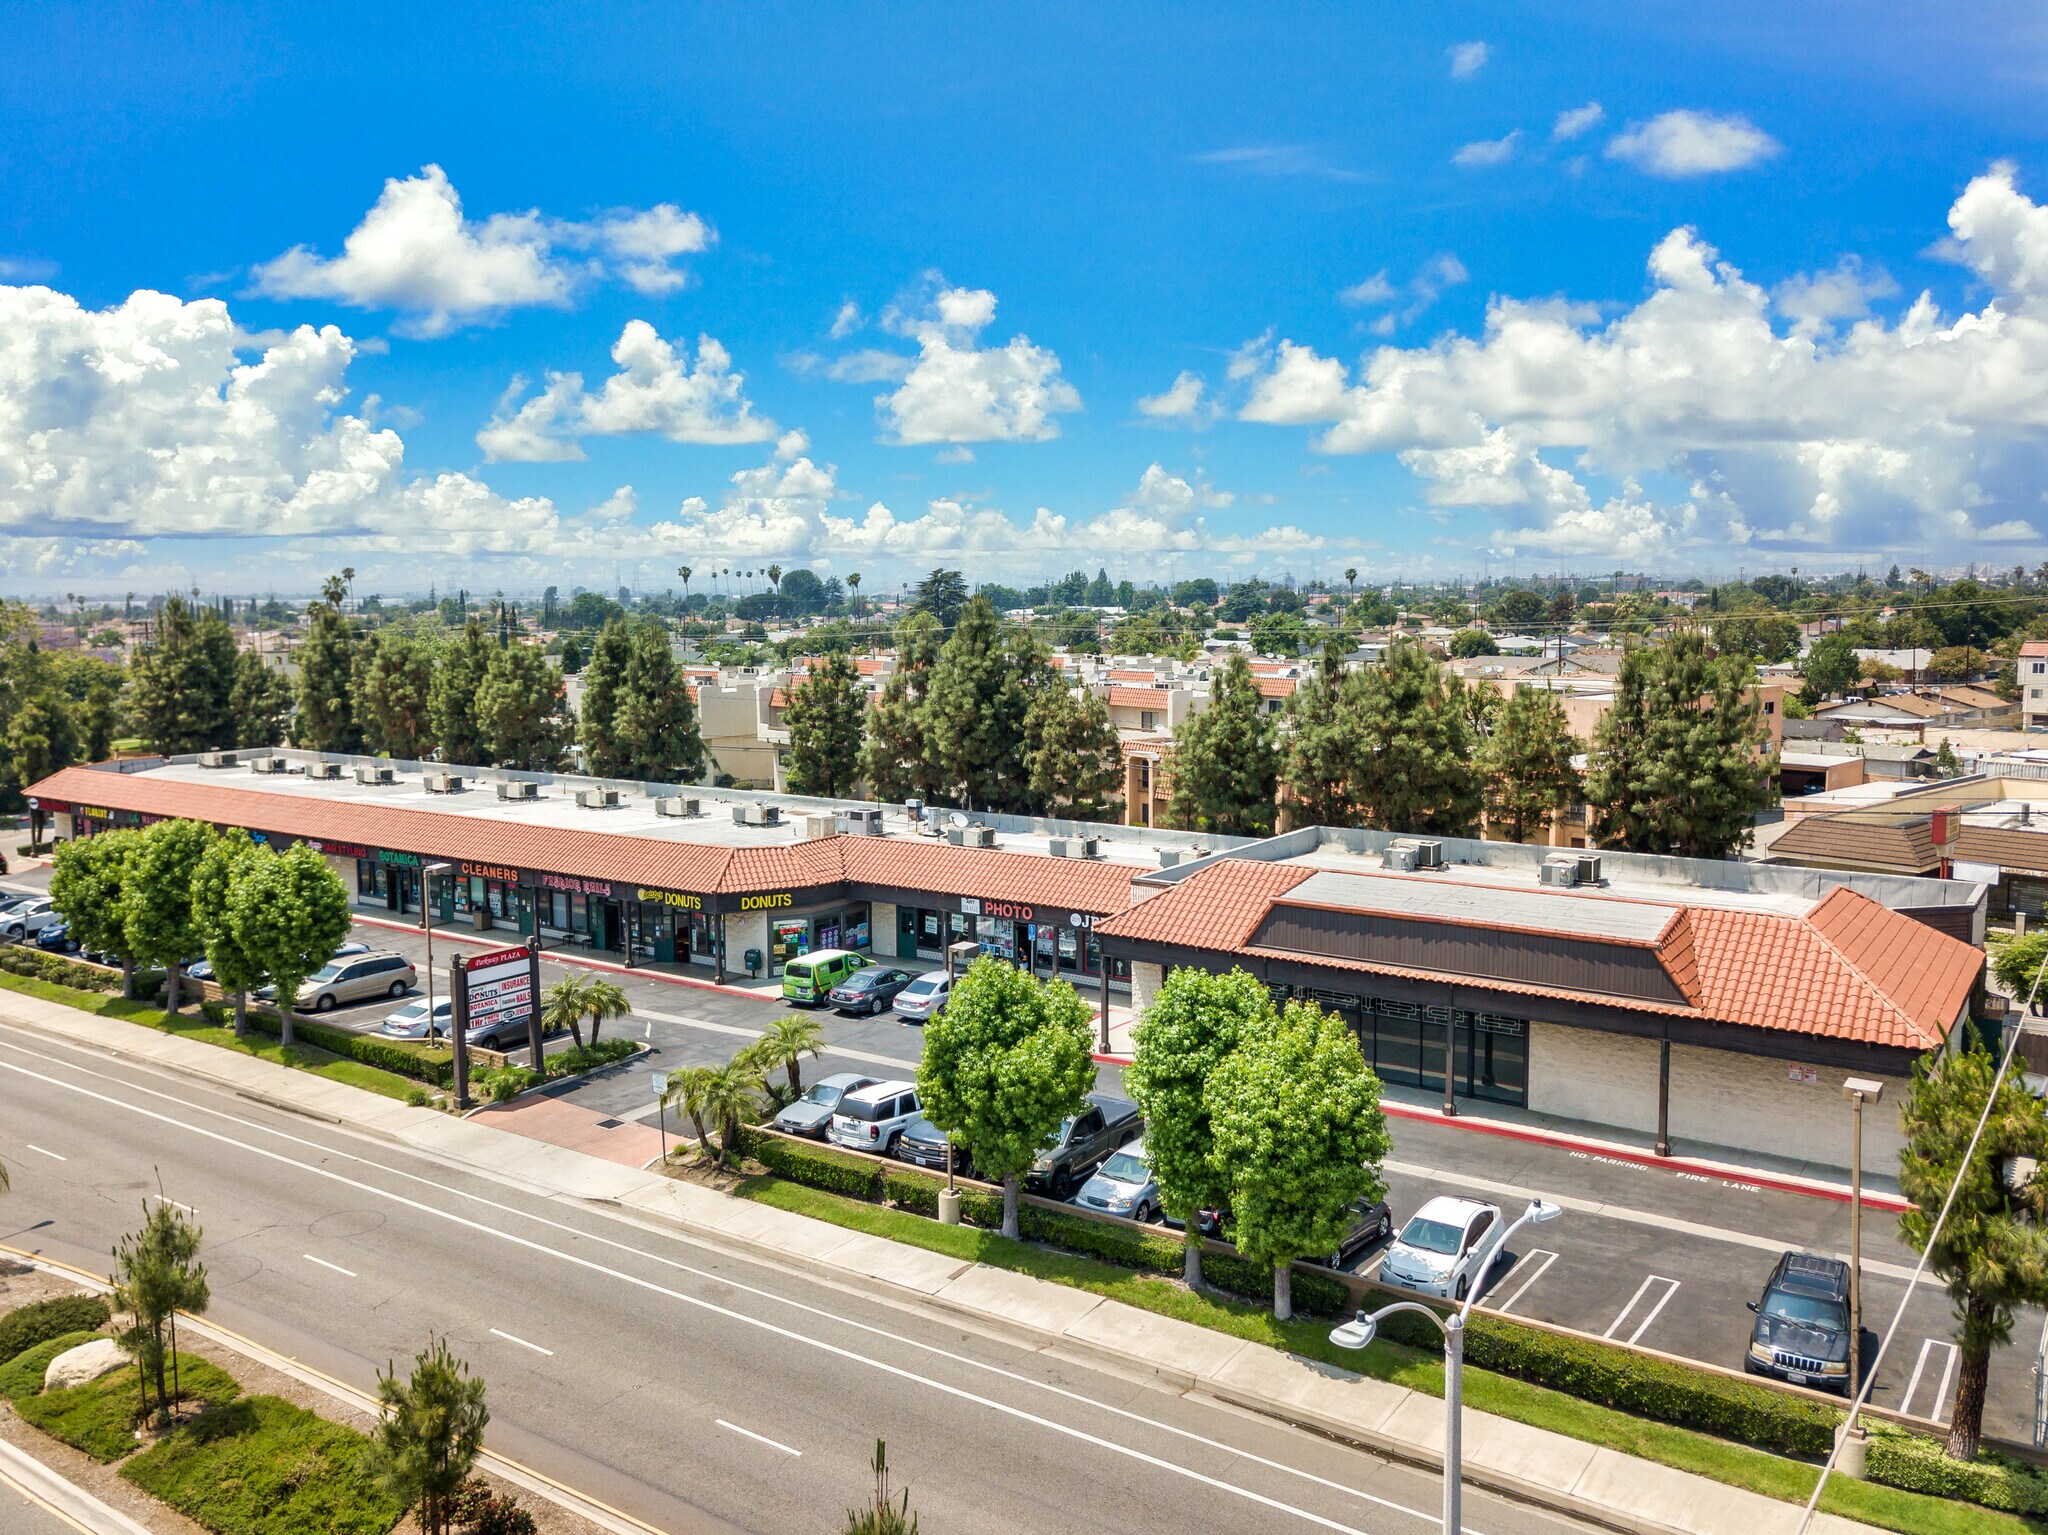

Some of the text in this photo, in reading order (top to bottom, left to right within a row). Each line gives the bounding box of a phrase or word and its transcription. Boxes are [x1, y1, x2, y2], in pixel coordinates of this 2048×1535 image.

[85, 806, 108, 819] FLORIST
[379, 850, 419, 867] BOTANICA
[461, 862, 519, 882] CLEANERS
[542, 875, 611, 897] FASHION NAILS
[664, 892, 702, 910] DONUTS
[741, 893, 792, 910] DONUTS
[984, 901, 1034, 921] PHOTO
[475, 952, 520, 966] Parkway PLAZA
[501, 976, 529, 991] INSURANCE
[469, 989, 498, 1000] DONUTS
[516, 992, 531, 1003] NAILS
[470, 1000, 498, 1011] BOTANICA
[471, 1019, 483, 1027] 1Hr
[1593, 1155, 1648, 1170] PARKING
[1675, 1171, 1762, 1193] FIRE LANE
